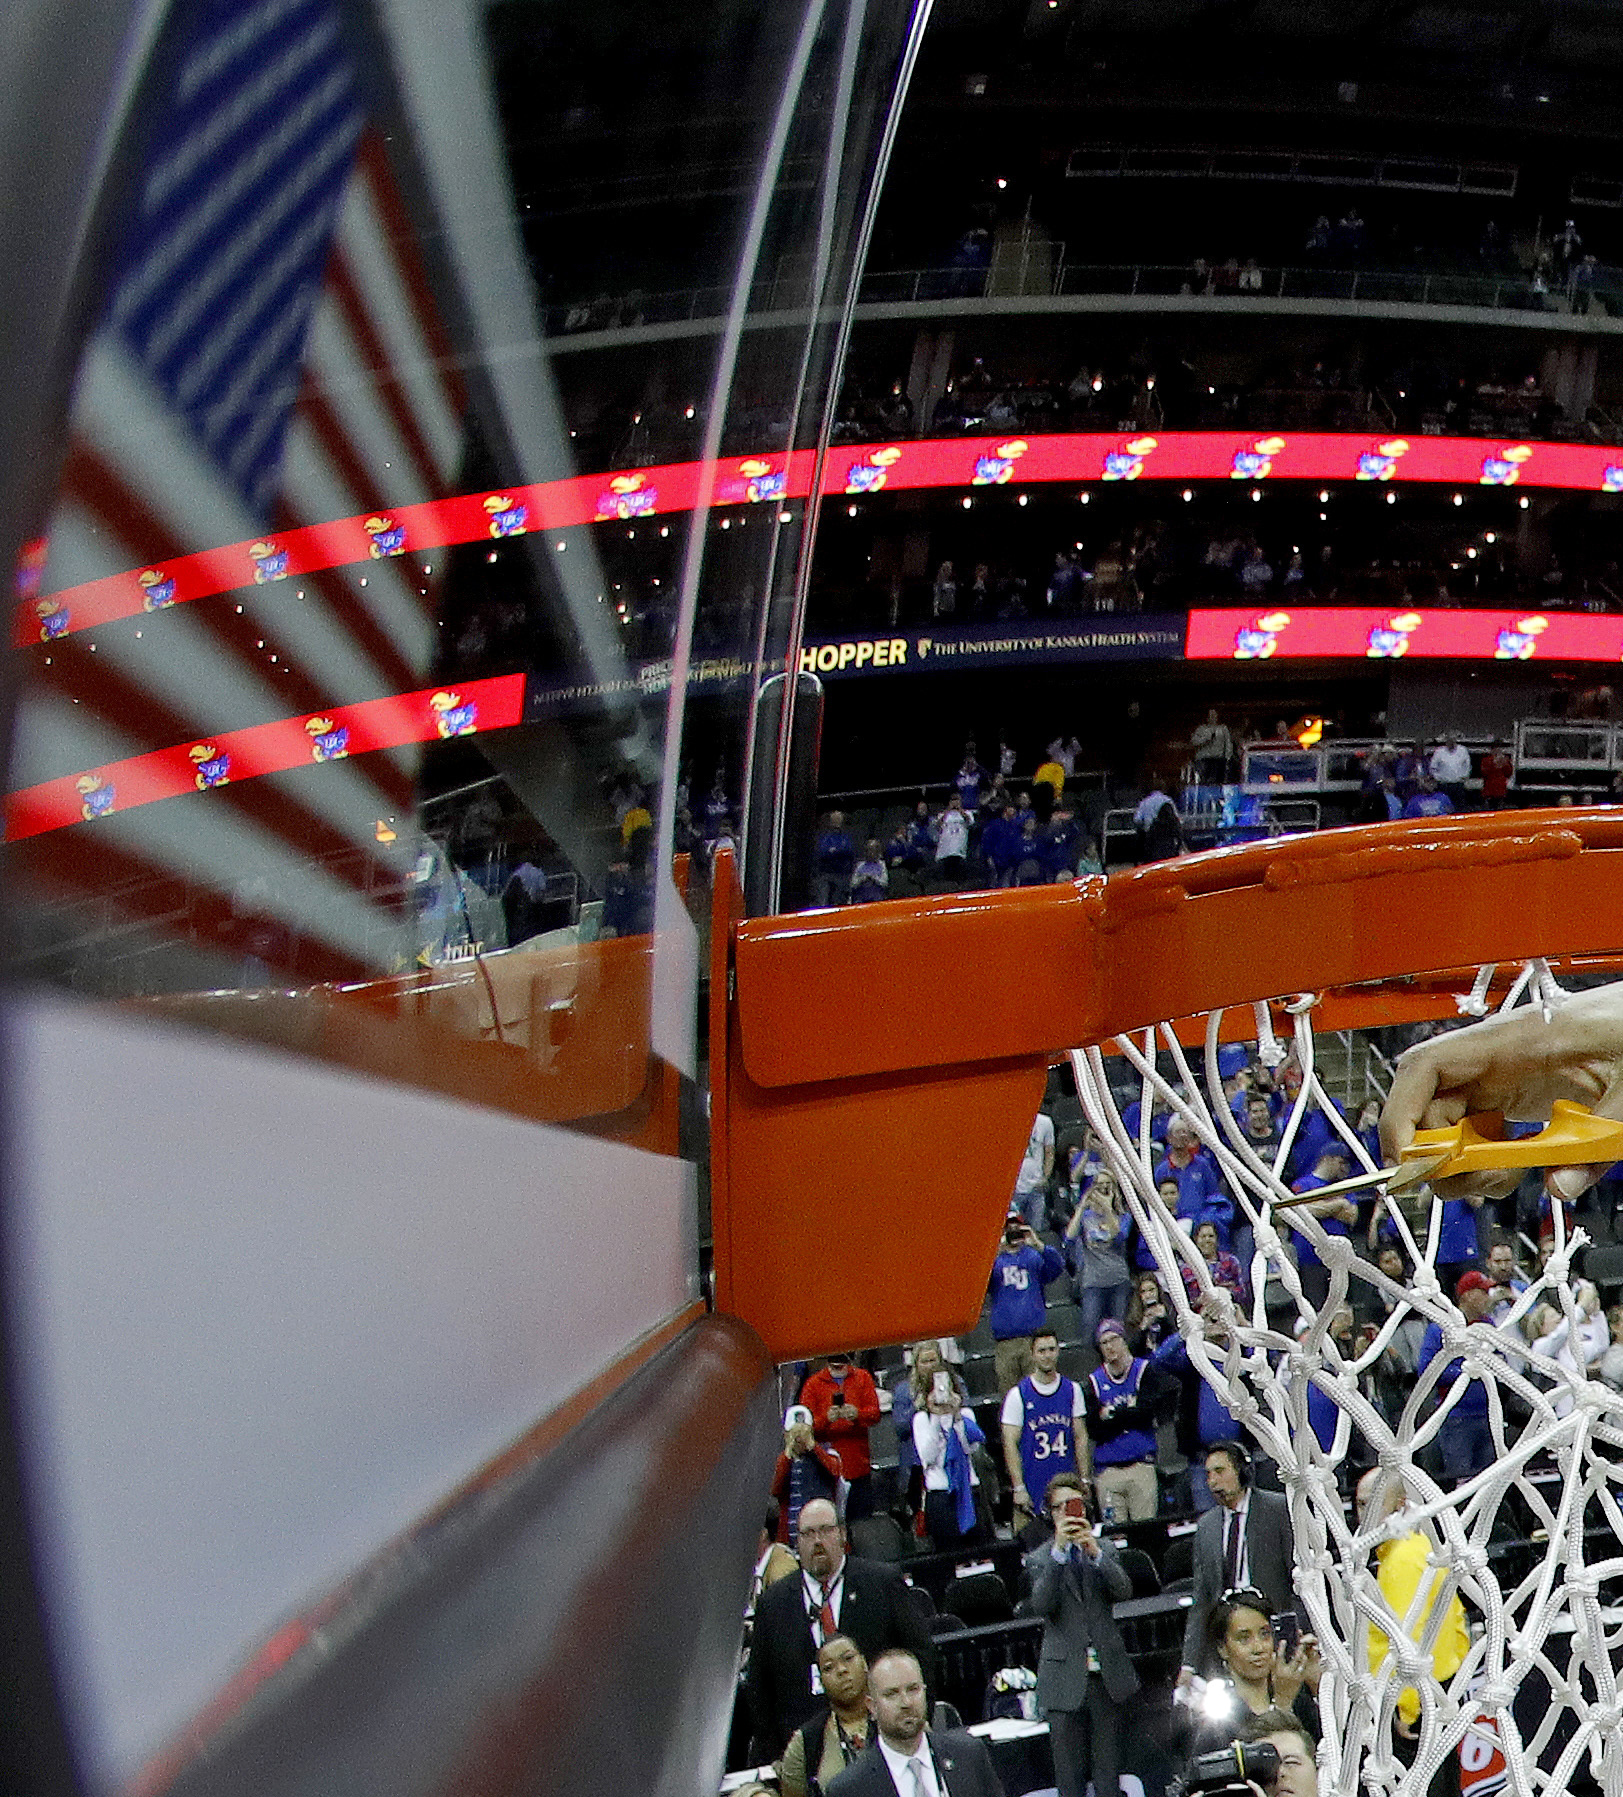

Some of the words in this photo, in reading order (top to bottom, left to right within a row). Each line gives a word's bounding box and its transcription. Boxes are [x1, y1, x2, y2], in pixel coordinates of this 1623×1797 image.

[1046, 634, 1091, 650] KANSAS
[1092, 633, 1138, 648] HEALTH
[1003, 1265, 1030, 1291] KU
[1034, 1430, 1068, 1460] 34
